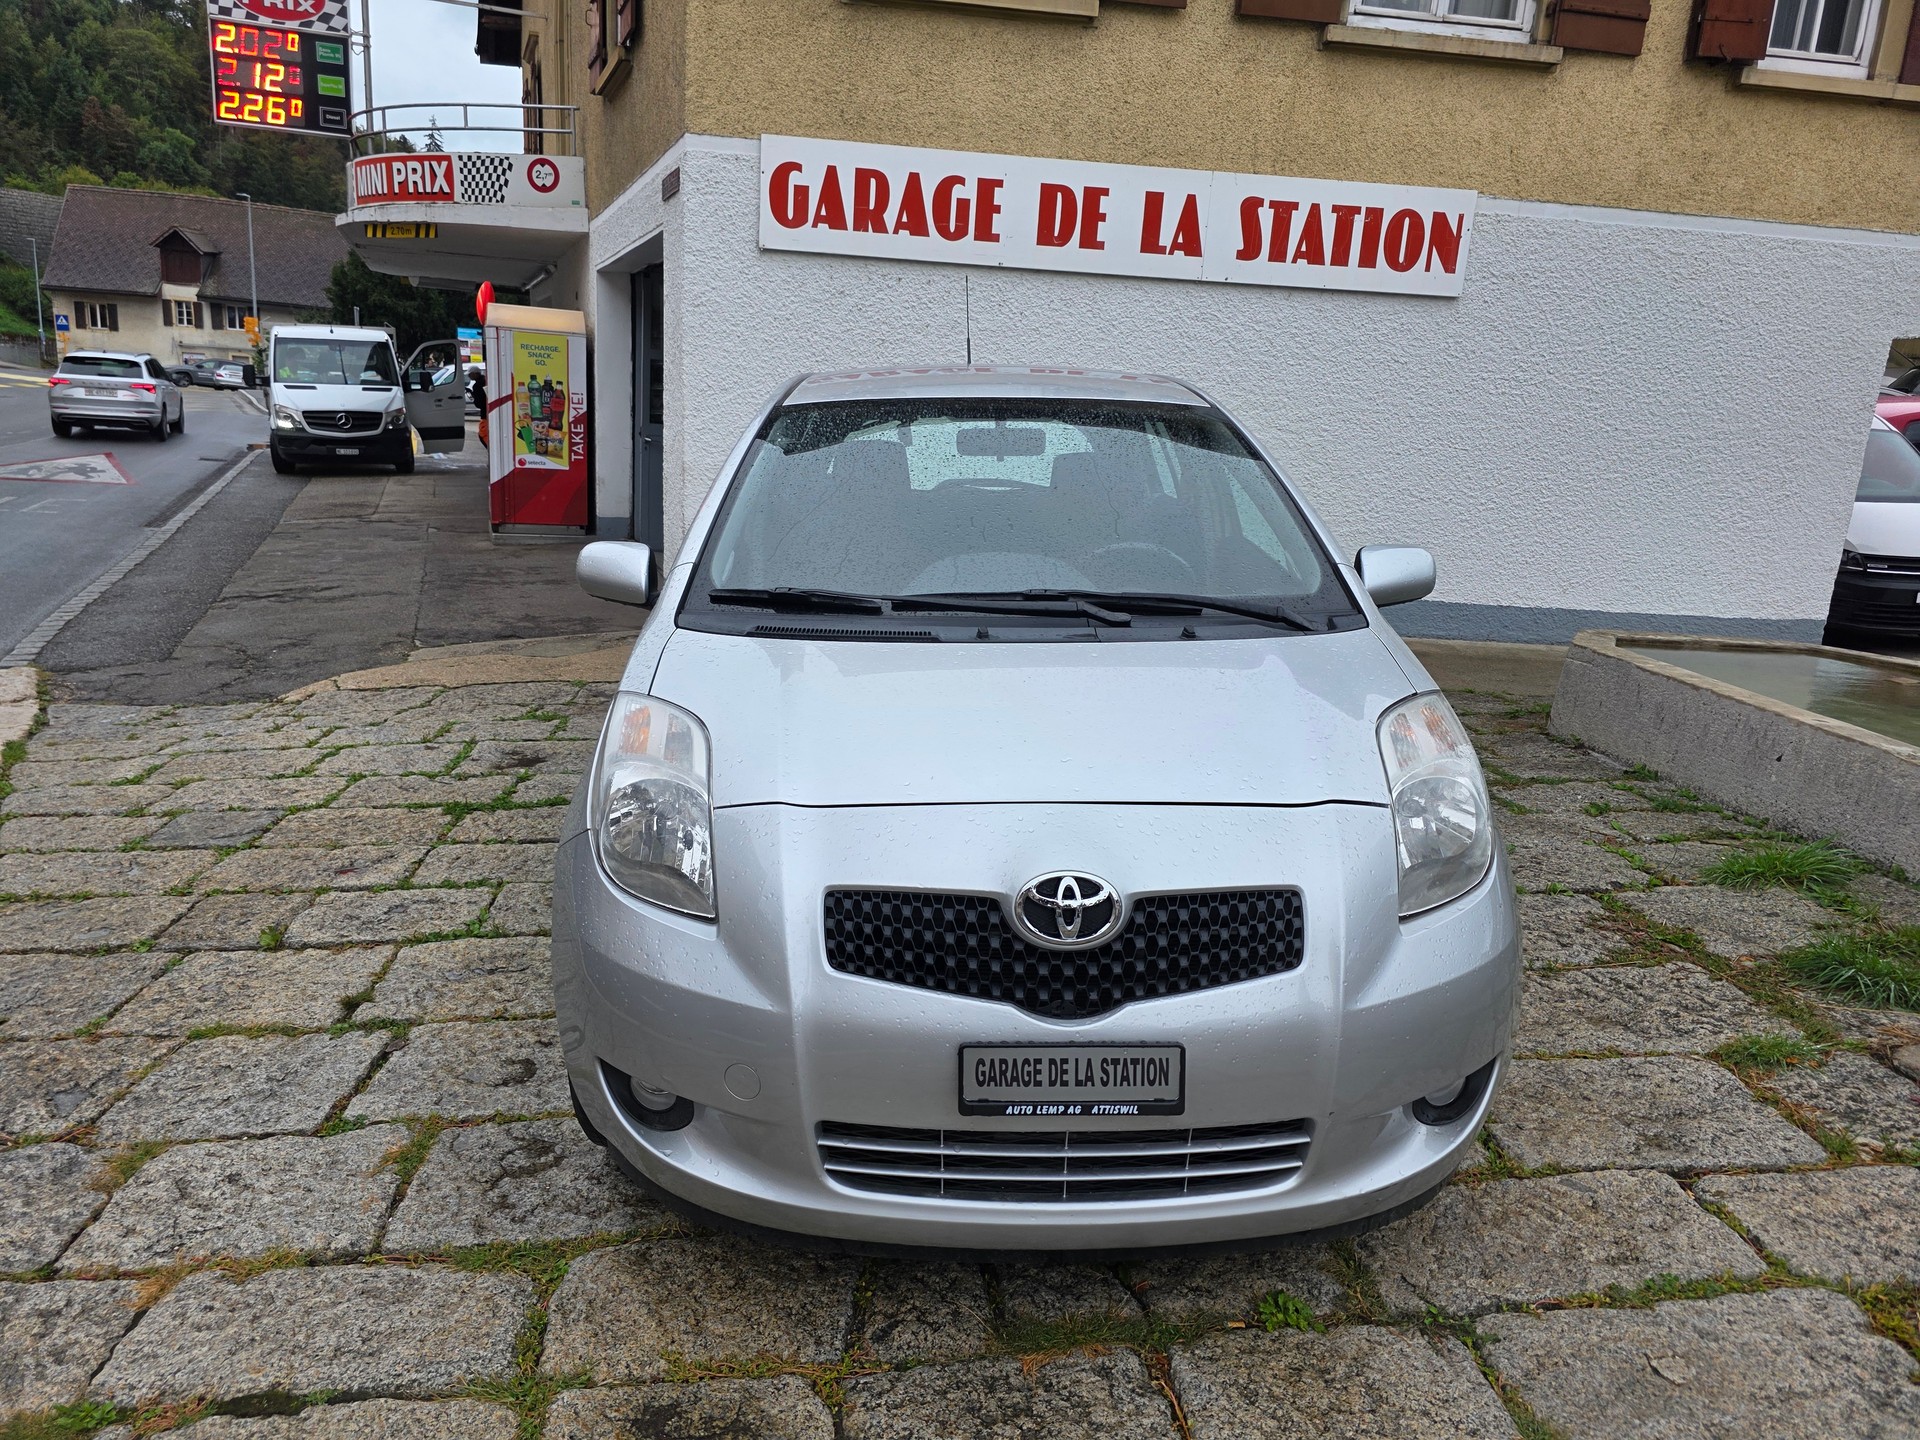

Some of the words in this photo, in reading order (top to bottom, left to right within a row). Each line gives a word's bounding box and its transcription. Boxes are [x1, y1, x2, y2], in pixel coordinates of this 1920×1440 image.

[242, 0, 317, 14] IX
[357, 162, 388, 197] MINI
[391, 161, 451, 194] PRIX
[768, 161, 1004, 243] GARAGE
[1036, 182, 1110, 251] DE
[1140, 190, 1203, 258] LA
[1235, 196, 1465, 275] STATION
[520, 343, 561, 353] RECHARGE.
[527, 351, 554, 360] SNACK.
[535, 359, 548, 367] GO.
[571, 392, 584, 419] ME!
[571, 423, 584, 462] TAKE
[974, 1057, 1043, 1088] GARAGE
[1048, 1057, 1070, 1088] DE
[1074, 1057, 1096, 1088] LA
[1099, 1057, 1170, 1088] STATION
[1005, 1105, 1034, 1115] AUTO
[1036, 1105, 1065, 1115] LEMP
[1067, 1105, 1082, 1115] AG
[1091, 1105, 1139, 1115] ATTISWIL
